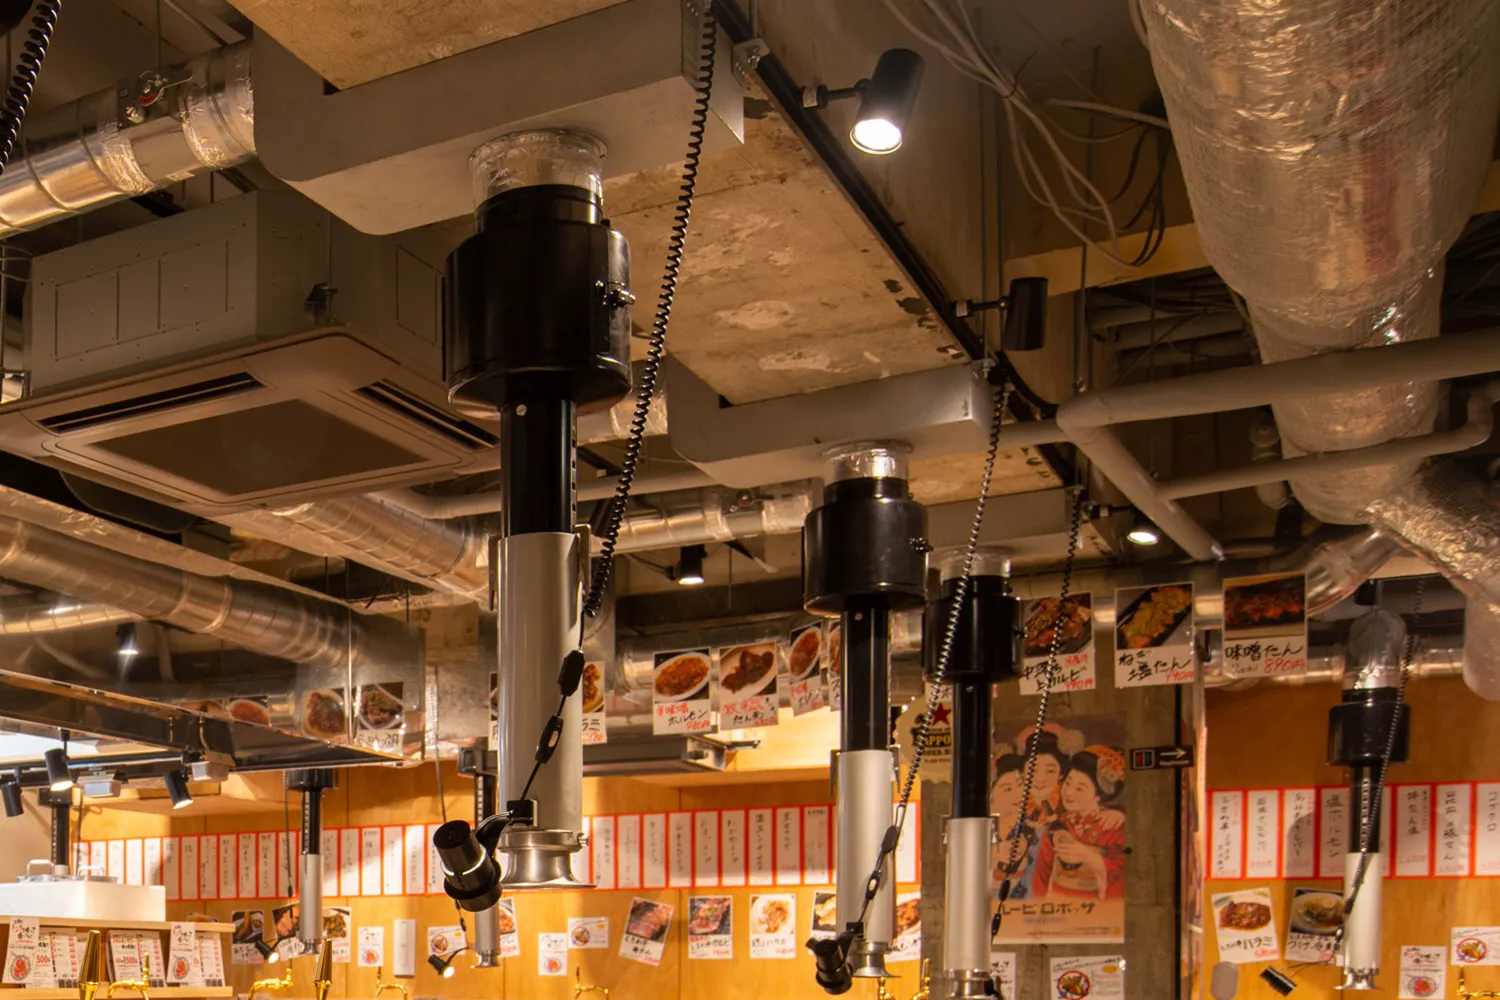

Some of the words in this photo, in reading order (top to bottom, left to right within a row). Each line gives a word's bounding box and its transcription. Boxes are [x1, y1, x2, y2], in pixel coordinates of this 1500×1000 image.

[1225, 641, 1303, 661] 味噌たん
[1127, 658, 1191, 682] 塩たん
[668, 709, 708, 726] ホルモン
